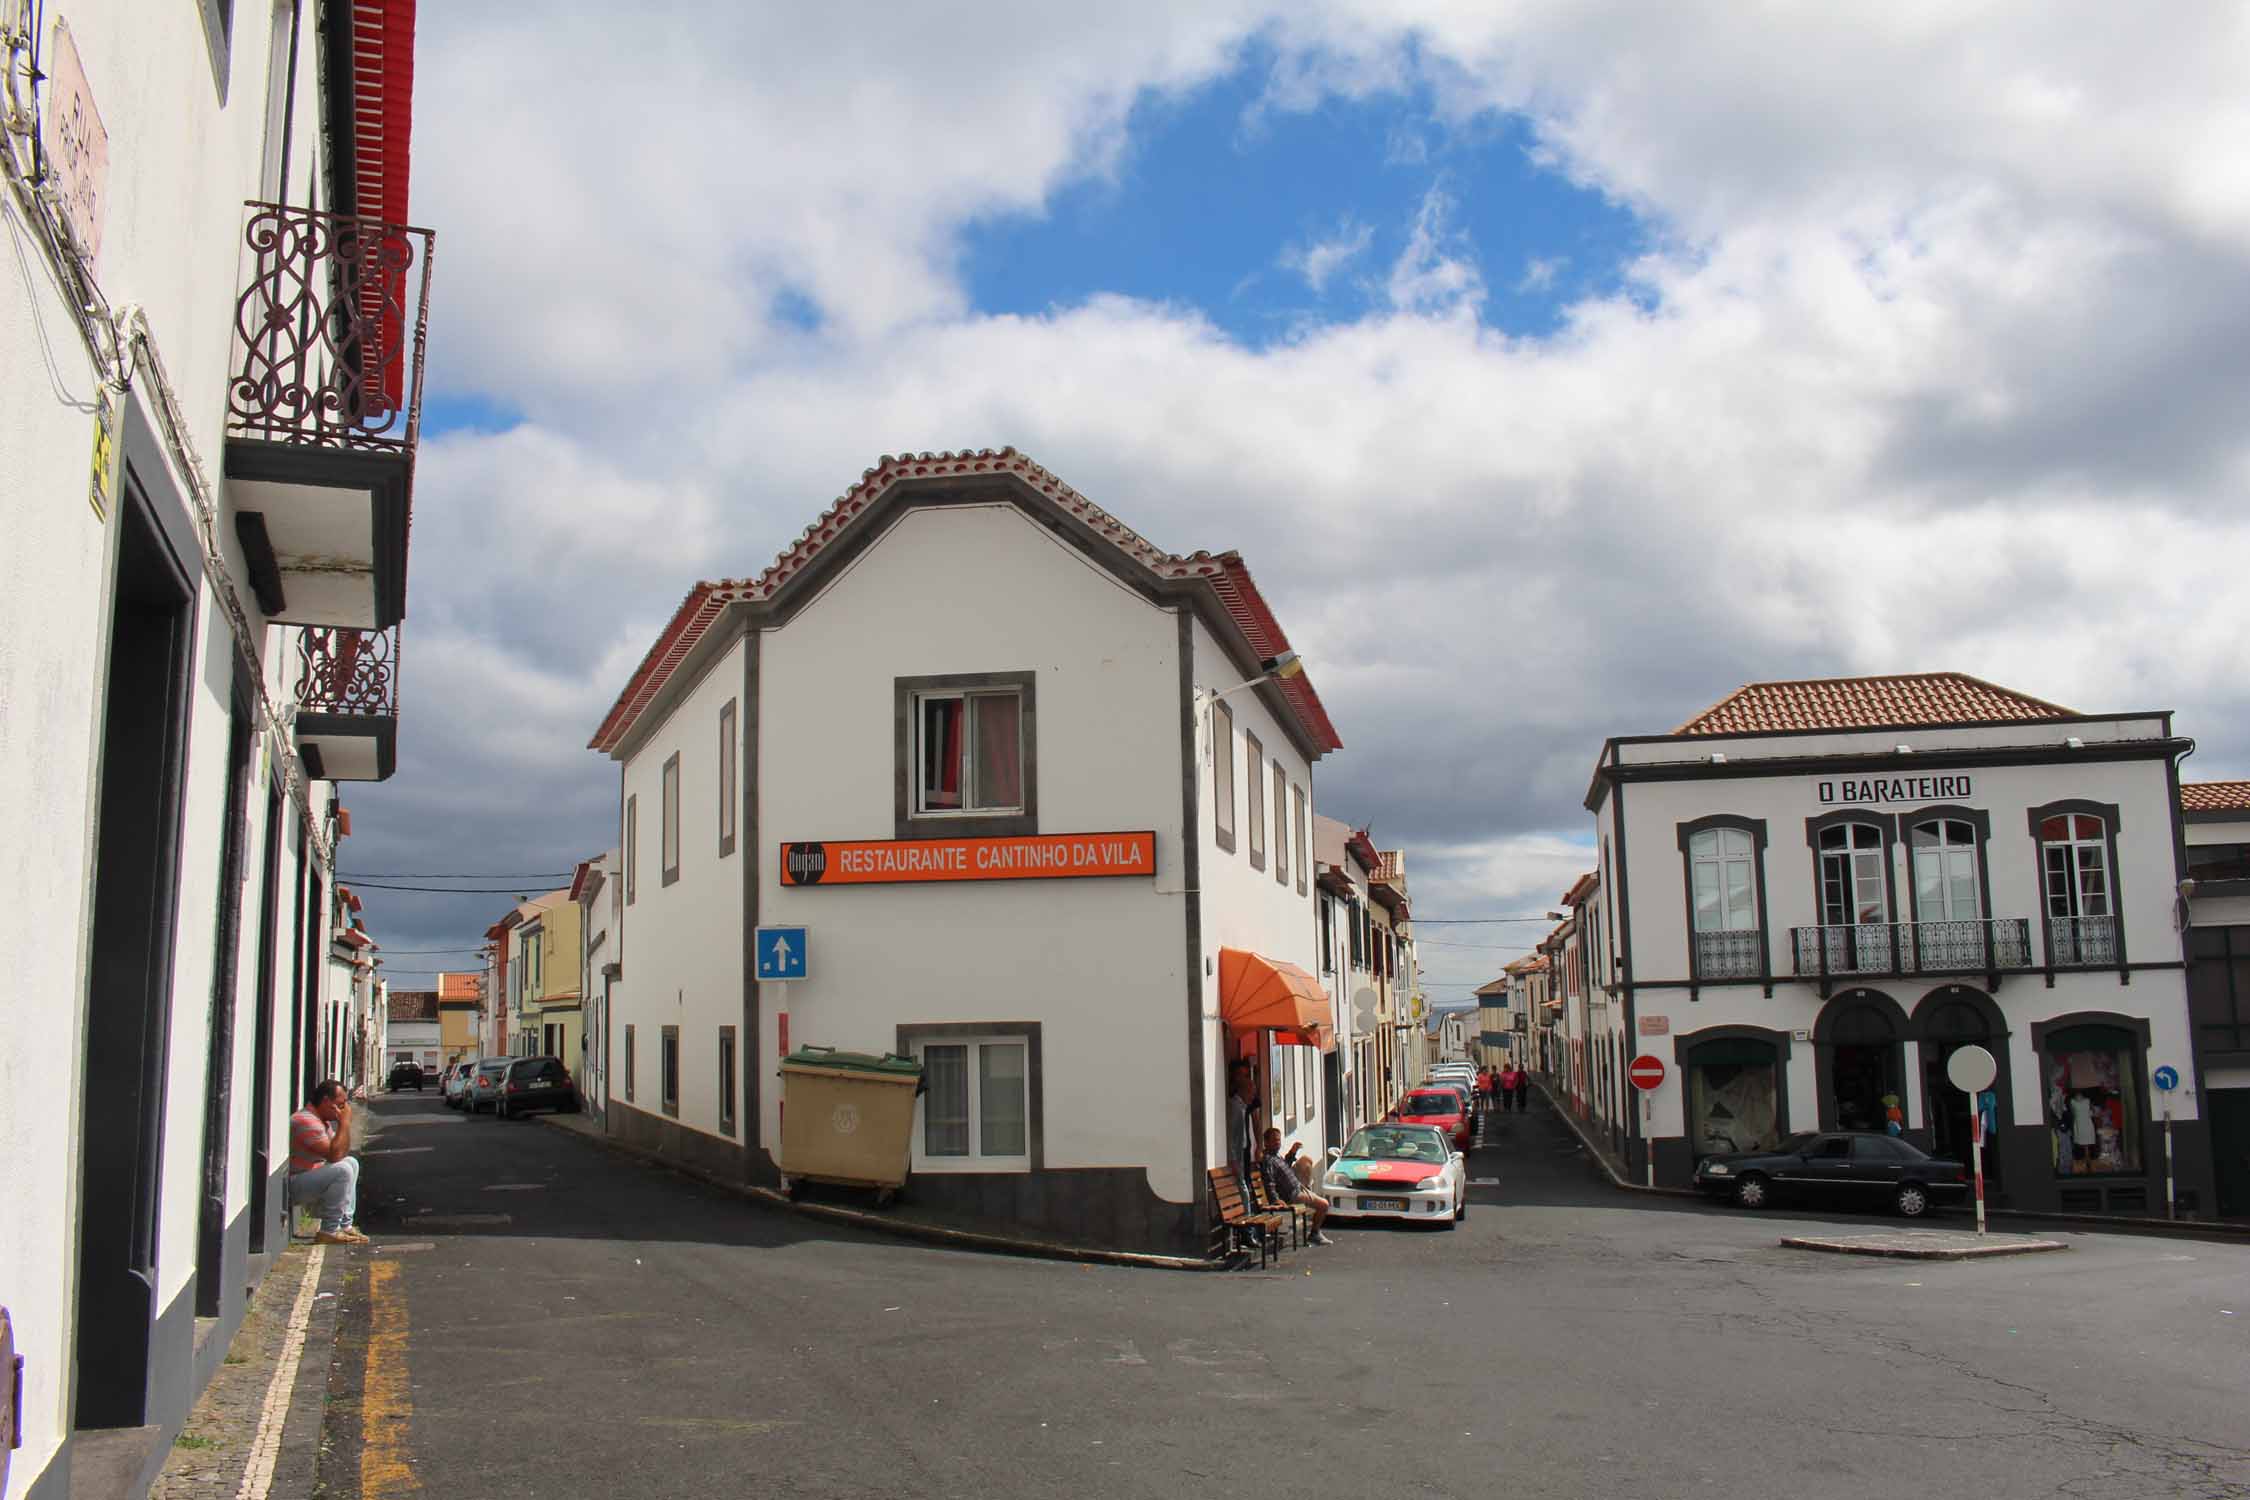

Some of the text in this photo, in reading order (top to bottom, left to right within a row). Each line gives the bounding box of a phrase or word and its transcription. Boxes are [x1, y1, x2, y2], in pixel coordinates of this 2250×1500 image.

[72, 91, 90, 163] RUA
[1819, 776, 1971, 803] O BARATEIRO
[840, 842, 1142, 872] RESTAURANTE CANTINHO DA VILA
